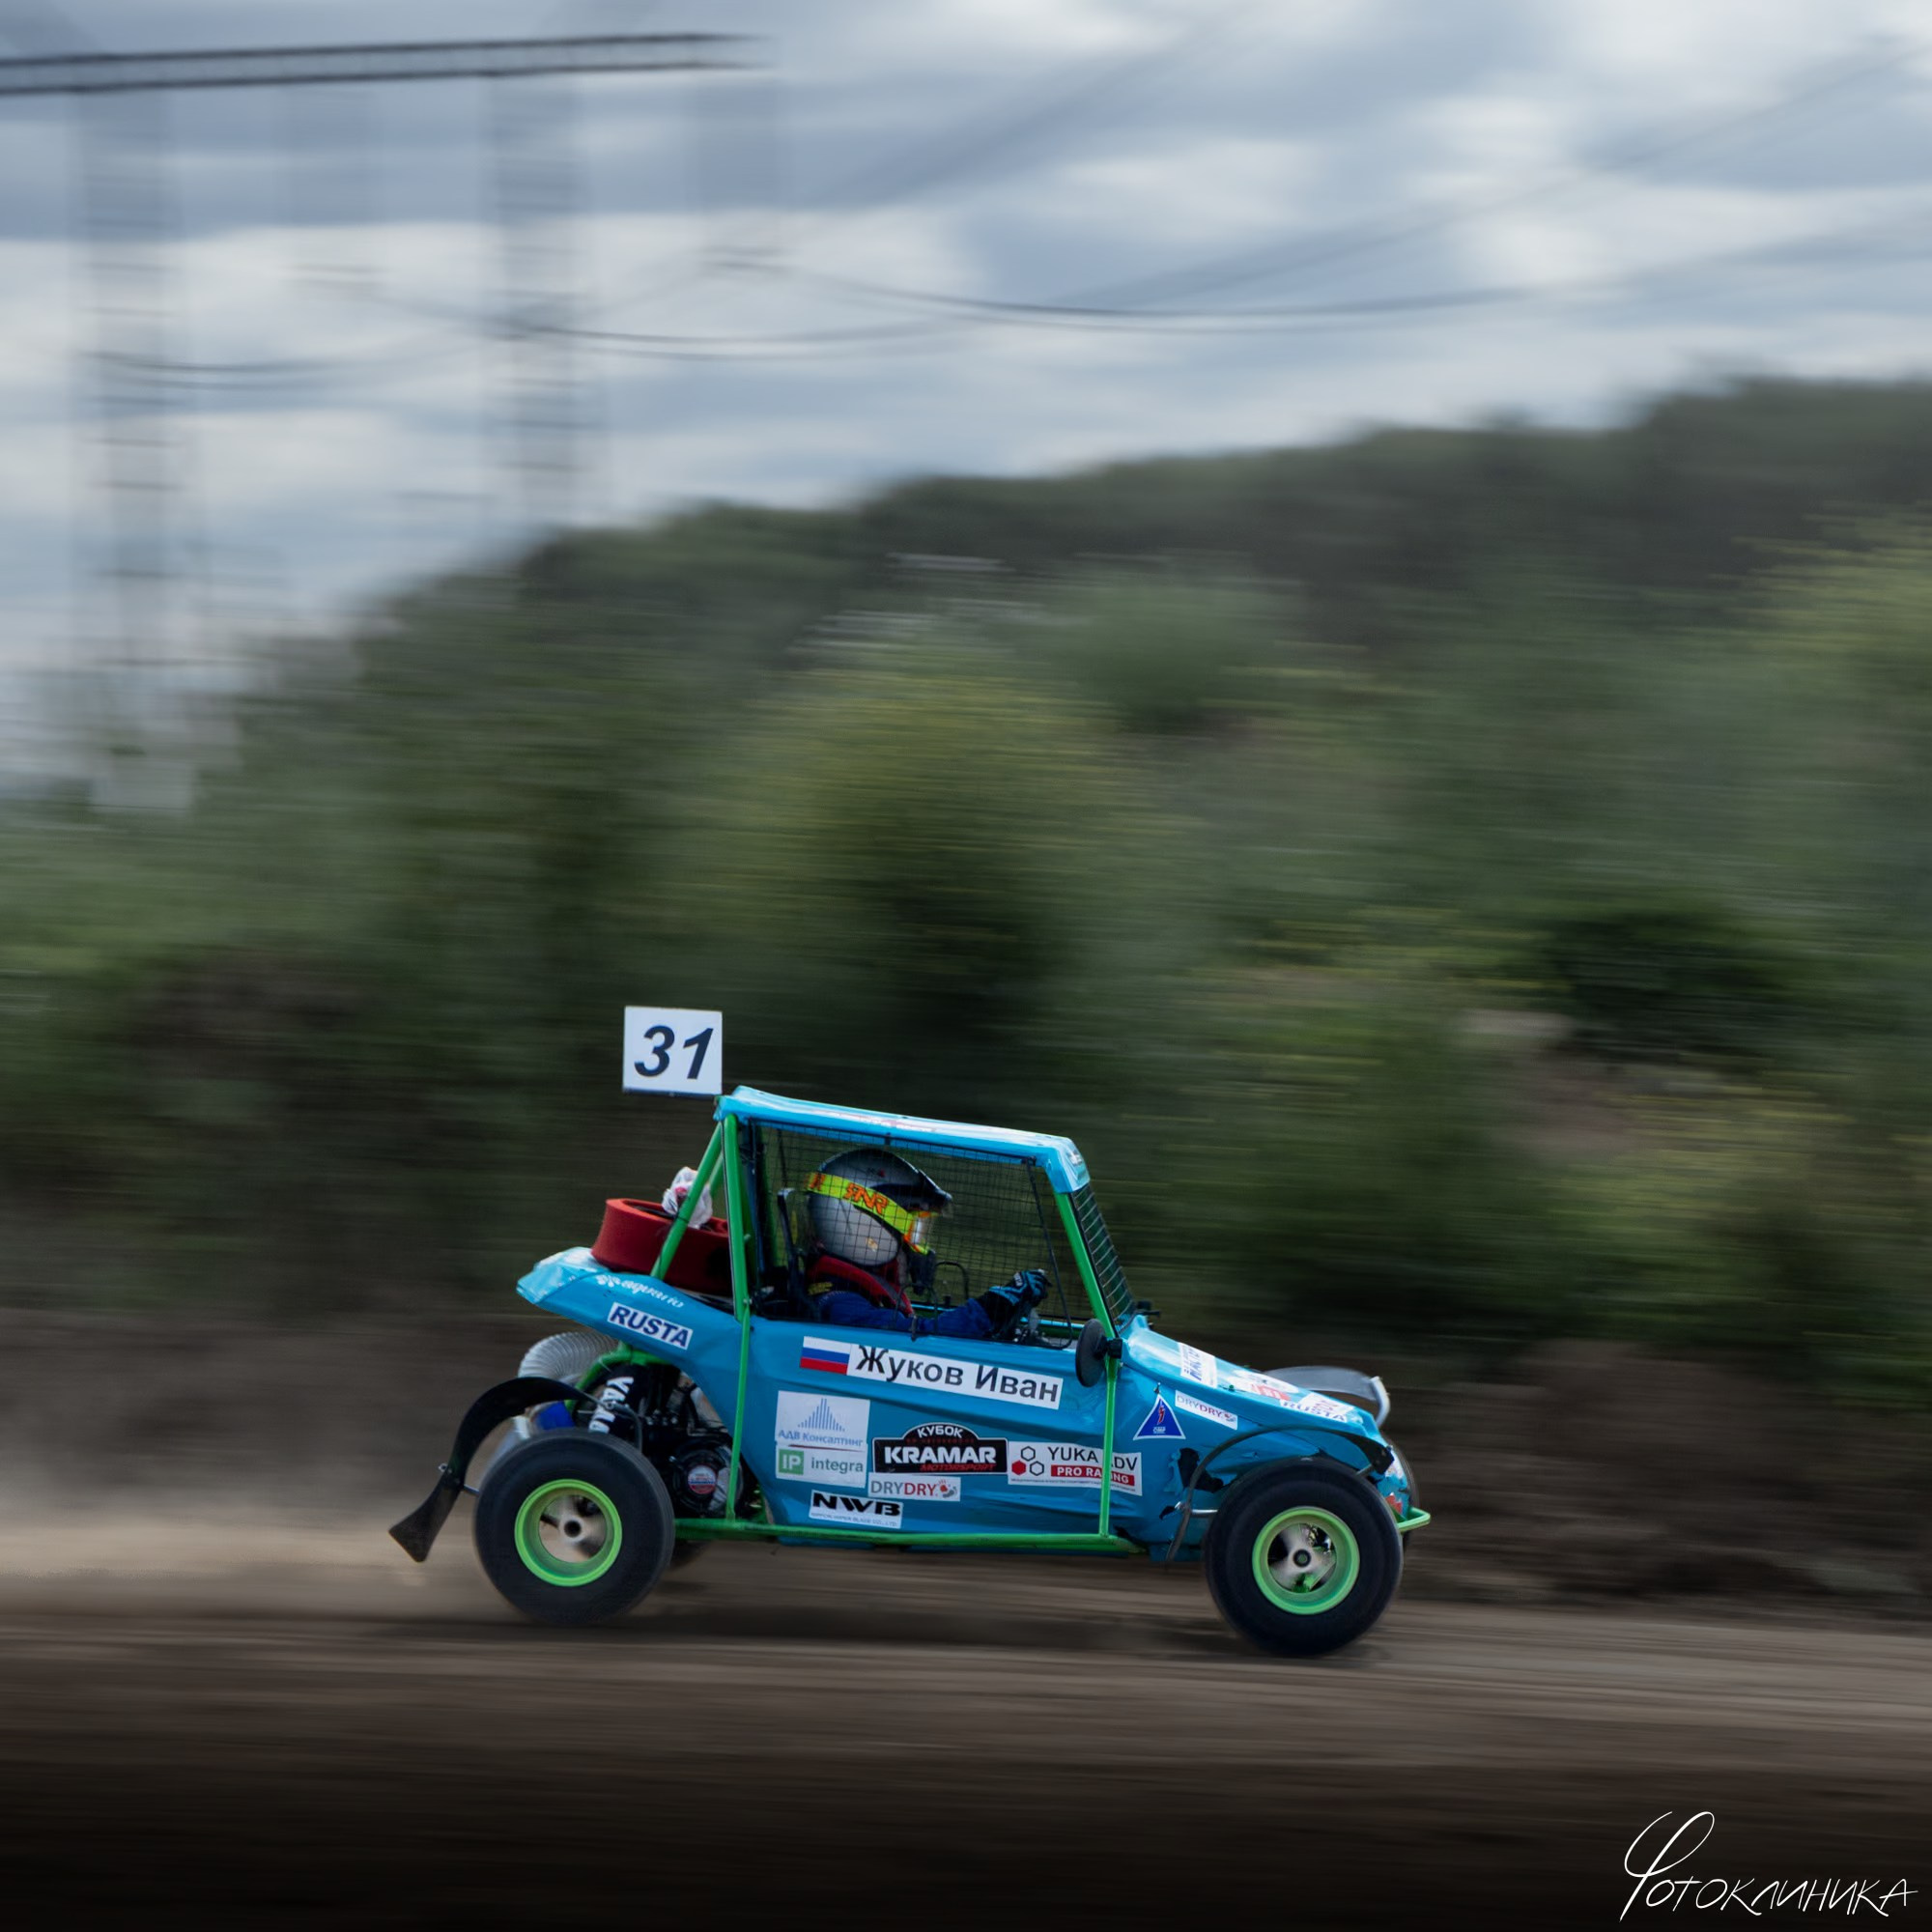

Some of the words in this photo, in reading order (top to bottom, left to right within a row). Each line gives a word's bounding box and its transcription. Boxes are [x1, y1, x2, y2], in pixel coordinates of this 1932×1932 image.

[634, 1025, 714, 1080] 31
[610, 1305, 689, 1348] RUSTA
[856, 1344, 964, 1386] Жуков
[975, 1364, 1059, 1403] Иван
[1178, 1395, 1222, 1417] DRYDRY
[779, 1430, 800, 1440] АДВ
[803, 1433, 864, 1446] Консалтинг
[917, 1425, 963, 1438] КУБОК
[884, 1446, 996, 1463] KRAMAR
[811, 1457, 864, 1474] integra
[1057, 1466, 1082, 1476] PRO
[1086, 1467, 1129, 1484] RANG
[870, 1480, 937, 1496] DRYDRY
[812, 1492, 900, 1517] NWB
